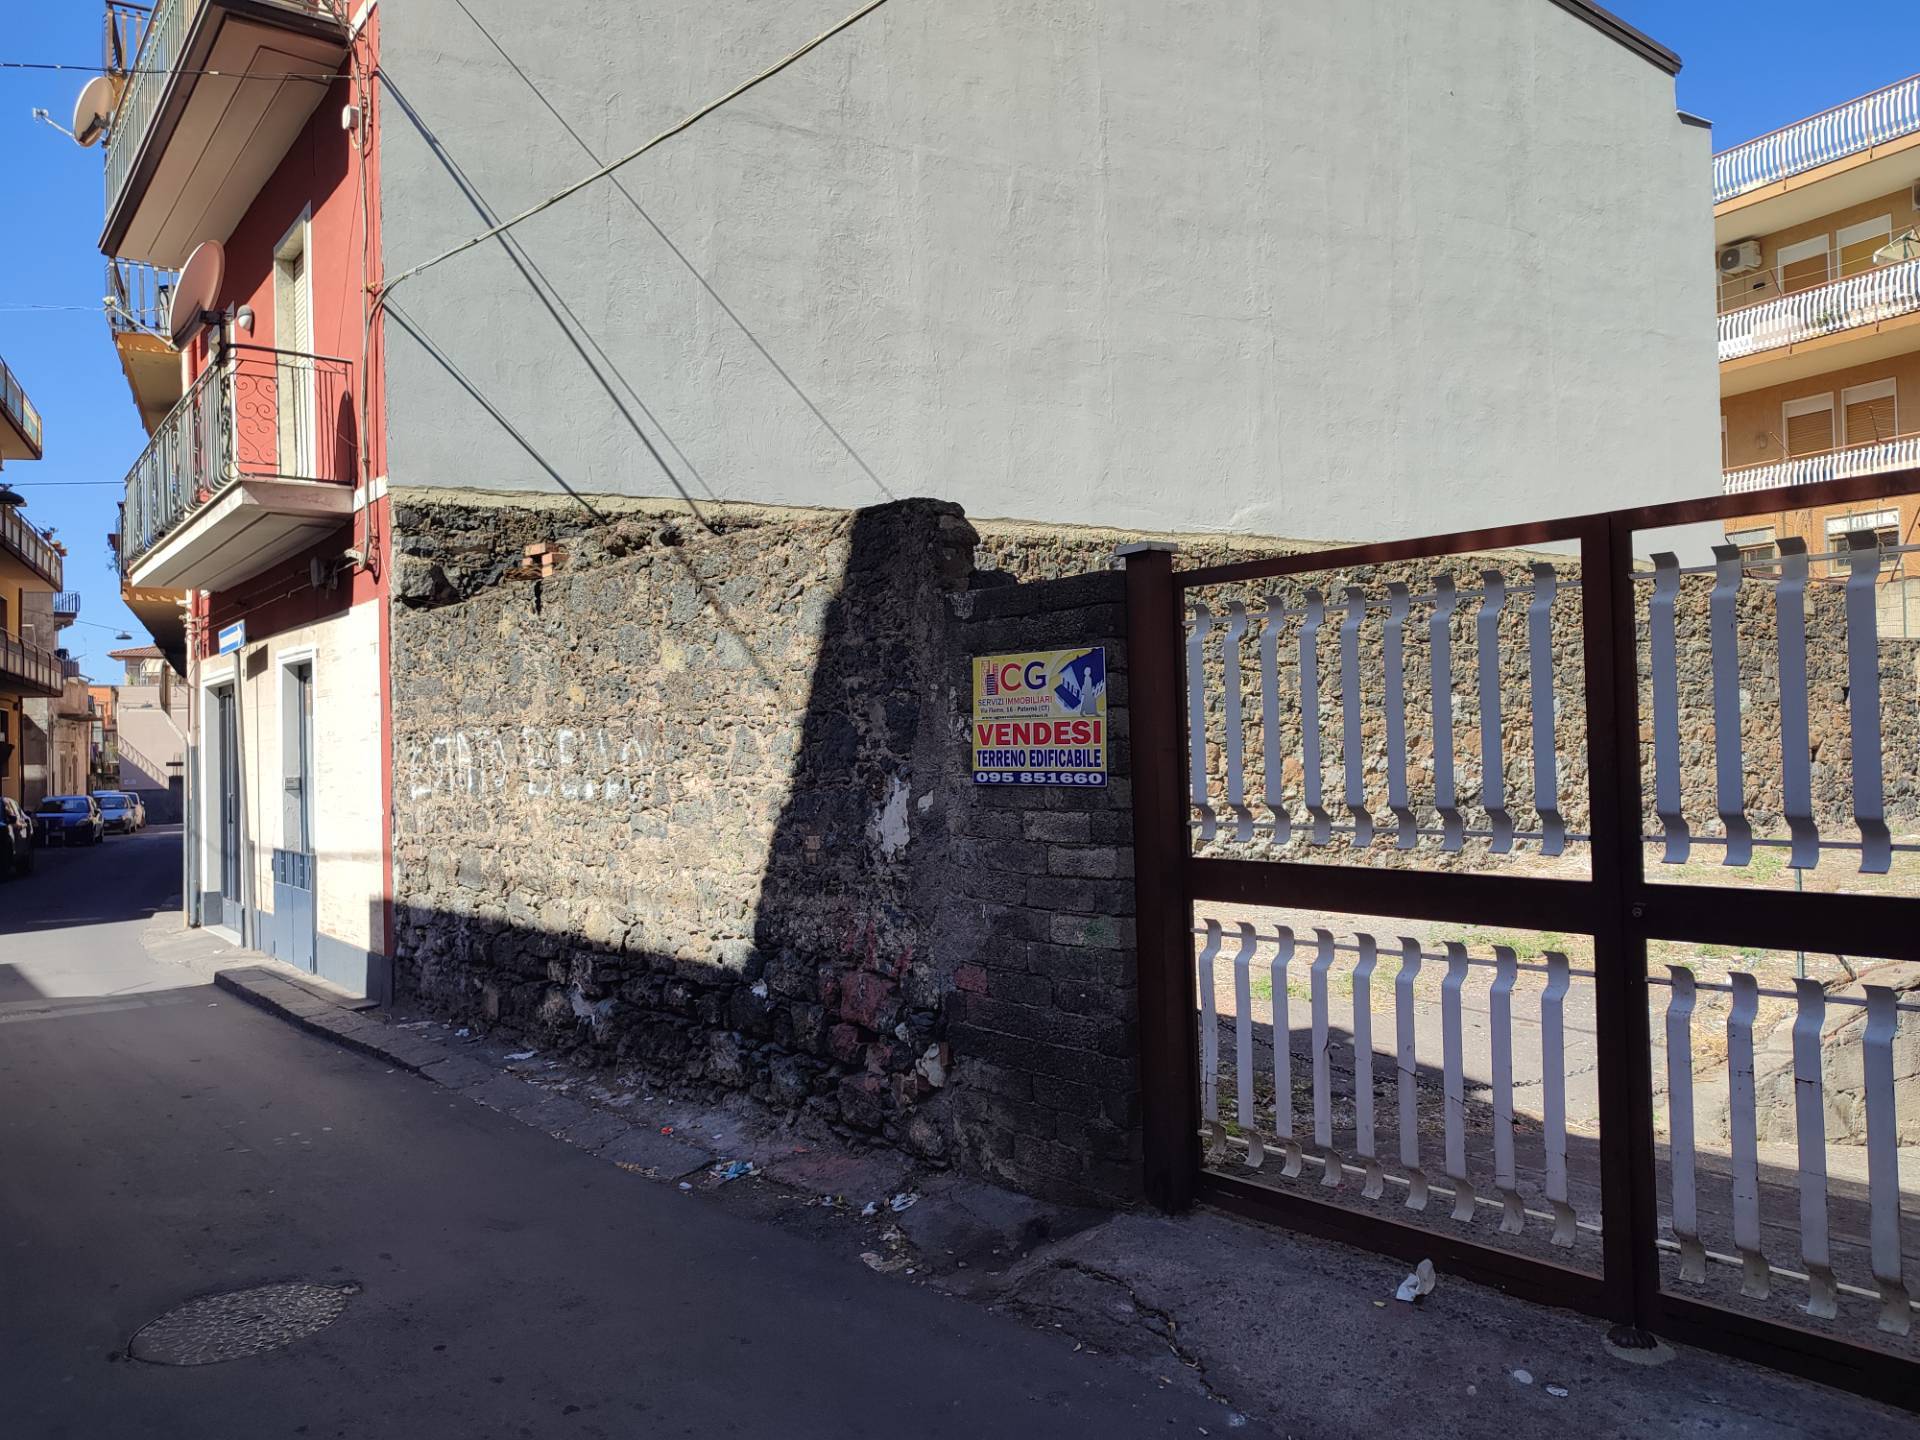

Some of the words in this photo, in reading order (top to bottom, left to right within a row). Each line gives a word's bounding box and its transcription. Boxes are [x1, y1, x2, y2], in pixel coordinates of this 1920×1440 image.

[978, 697, 1004, 706] SERVIZI
[1005, 696, 1053, 705] IMMOBILIARI
[976, 720, 1102, 746] VENDESI
[976, 749, 1026, 768] TERRENO
[1029, 748, 1103, 768] EDIFICABILE
[976, 772, 1014, 783] 095
[1020, 772, 1103, 784] 851660
